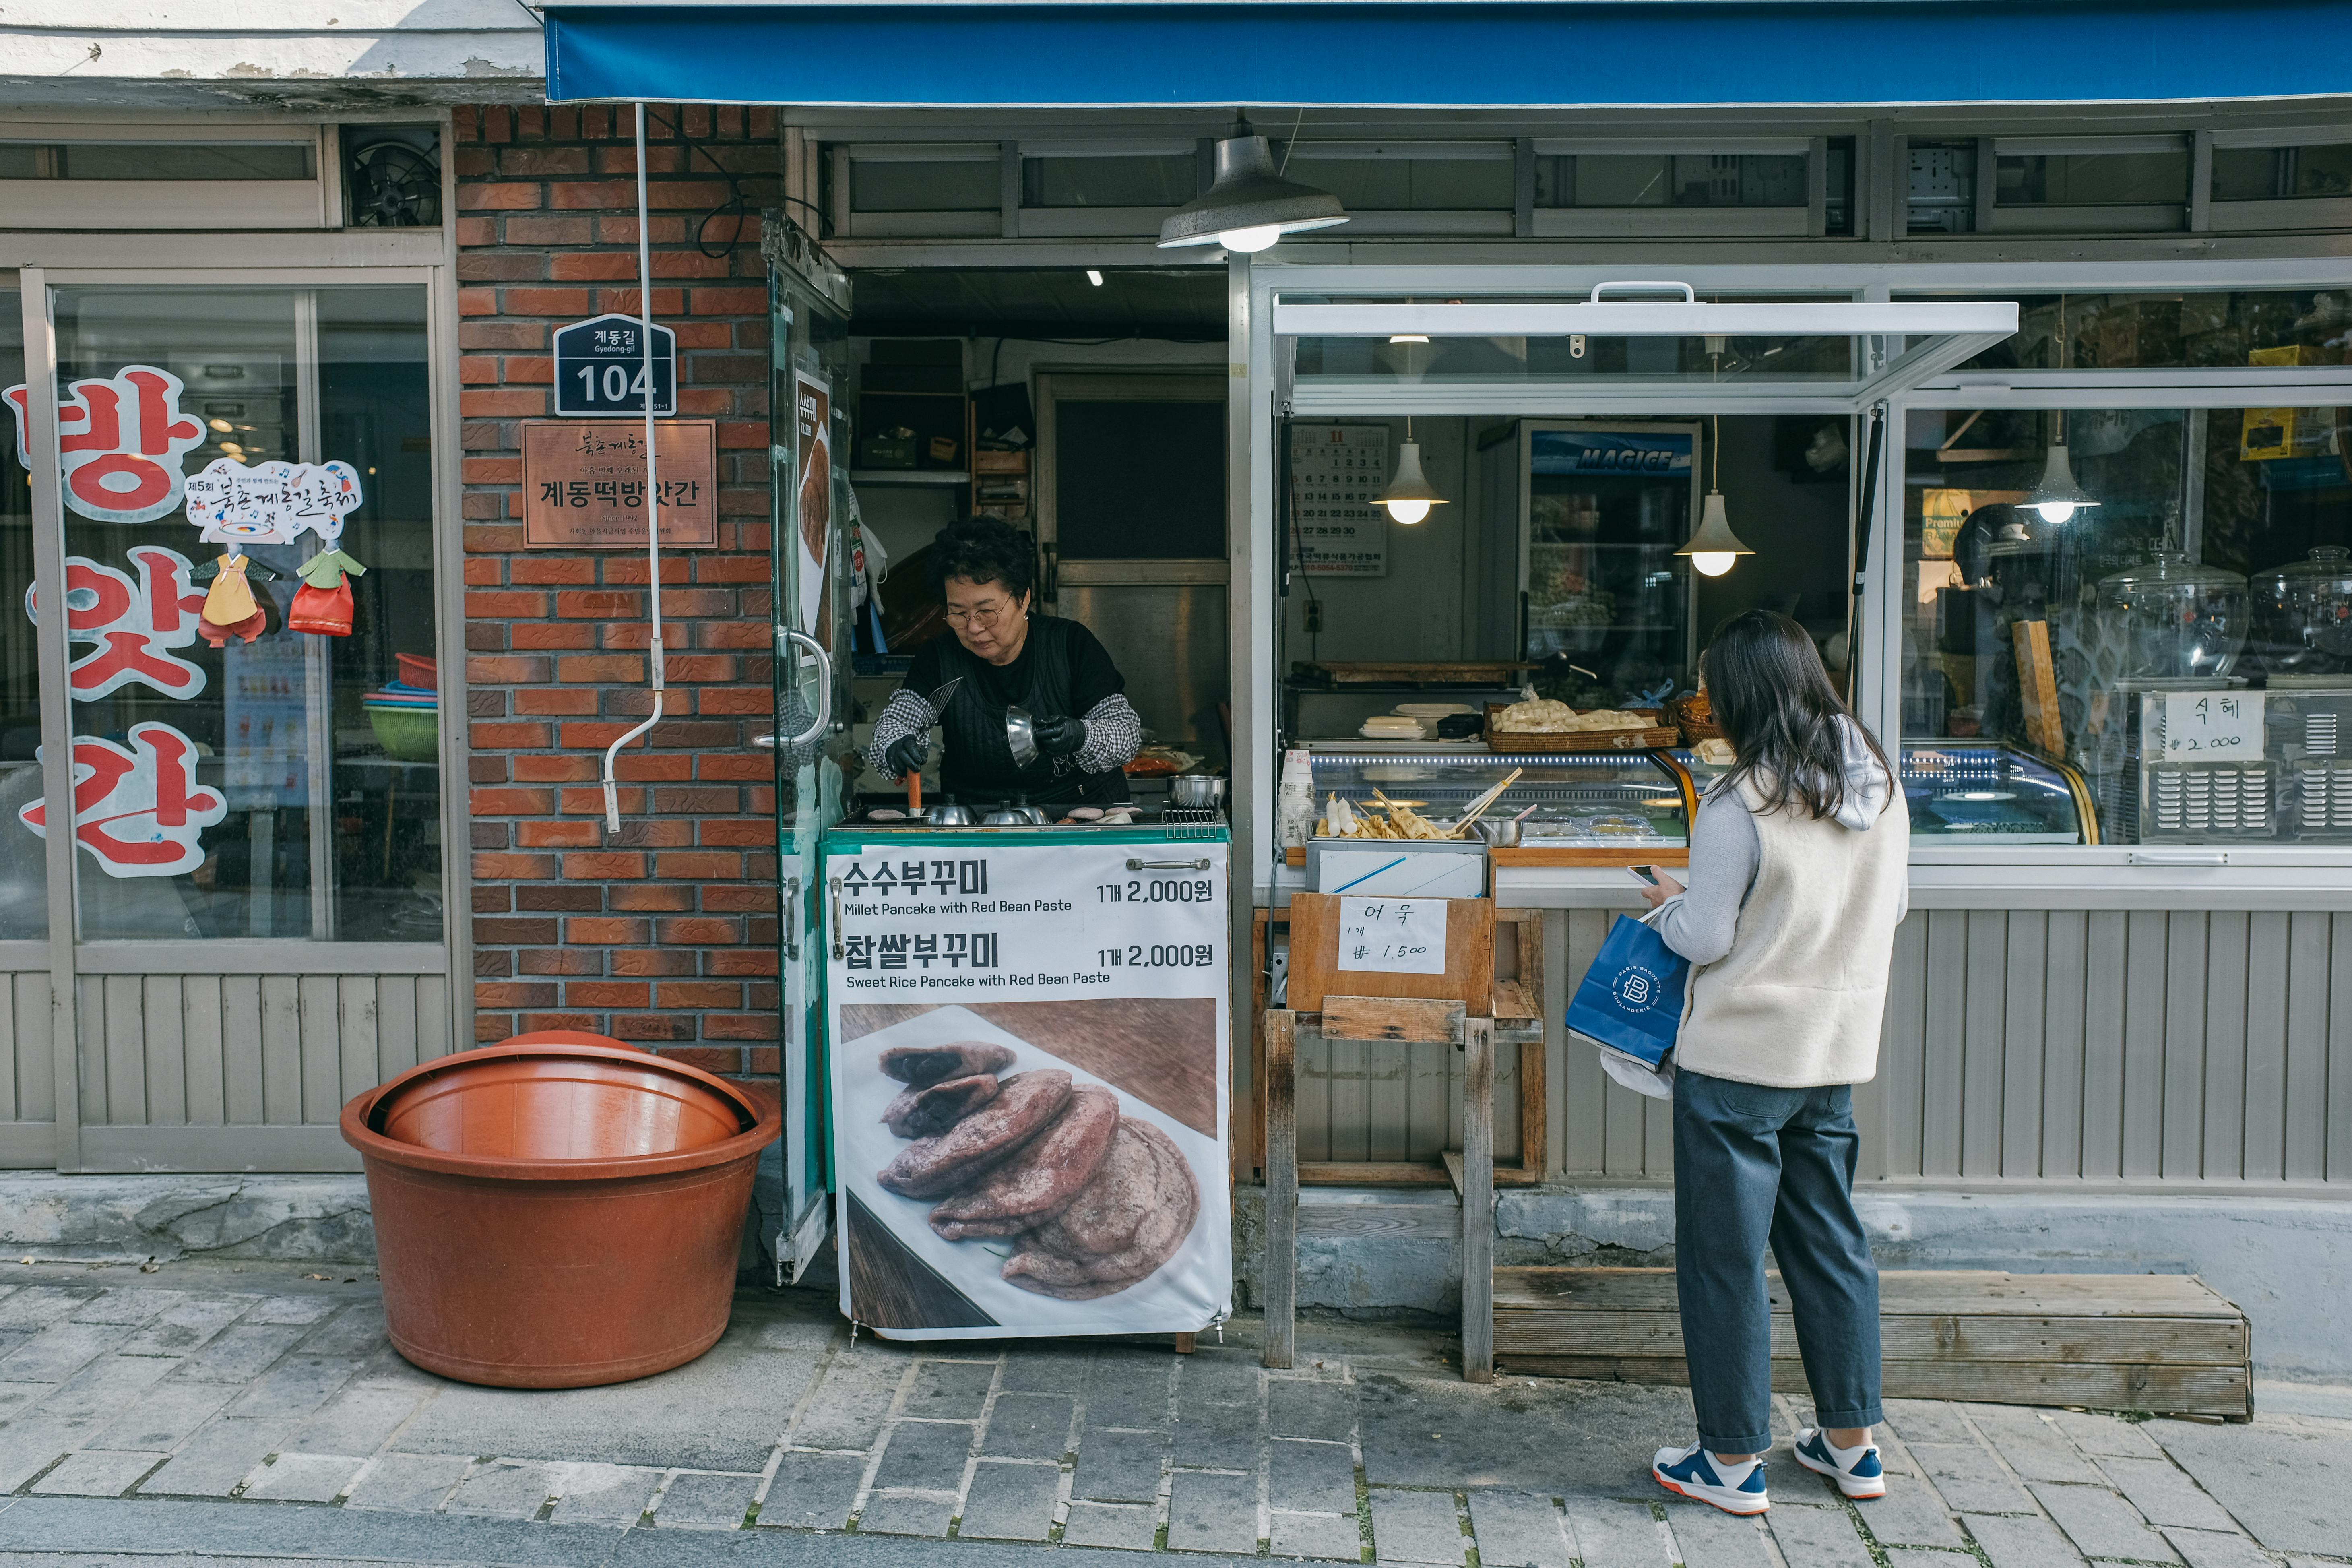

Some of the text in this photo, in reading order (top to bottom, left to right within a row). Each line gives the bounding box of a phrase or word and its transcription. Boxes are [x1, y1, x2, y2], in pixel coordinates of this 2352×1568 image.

[595, 330, 634, 345] 계동길
[595, 345, 635, 354] Gyedong-gil
[577, 365, 657, 401] 104
[1330, 430, 1343, 443] 11
[1576, 449, 1673, 471] MAGICE
[580, 466, 595, 475] 아홉
[599, 466, 613, 474] 번째
[617, 466, 639, 475] 오래된
[188, 481, 214, 492] 제5회
[541, 480, 700, 508] 계동떡방앗간
[1925, 516, 1964, 528] Premiu
[1926, 531, 1957, 541] BANA
[843, 859, 1212, 903] 수수부꾸미 1개 2,000원
[845, 899, 1072, 915] Millet Pancake with Red Bean Paste
[845, 932, 1213, 970] 찹쌀부꾸미 1개 2,000원
[847, 972, 1110, 987] Sweet Rice Pancake with Red Bean Paste
[1618, 965, 1661, 994] PARIS BAGUETTE
[1612, 991, 1650, 1014] BOULANGERIE
